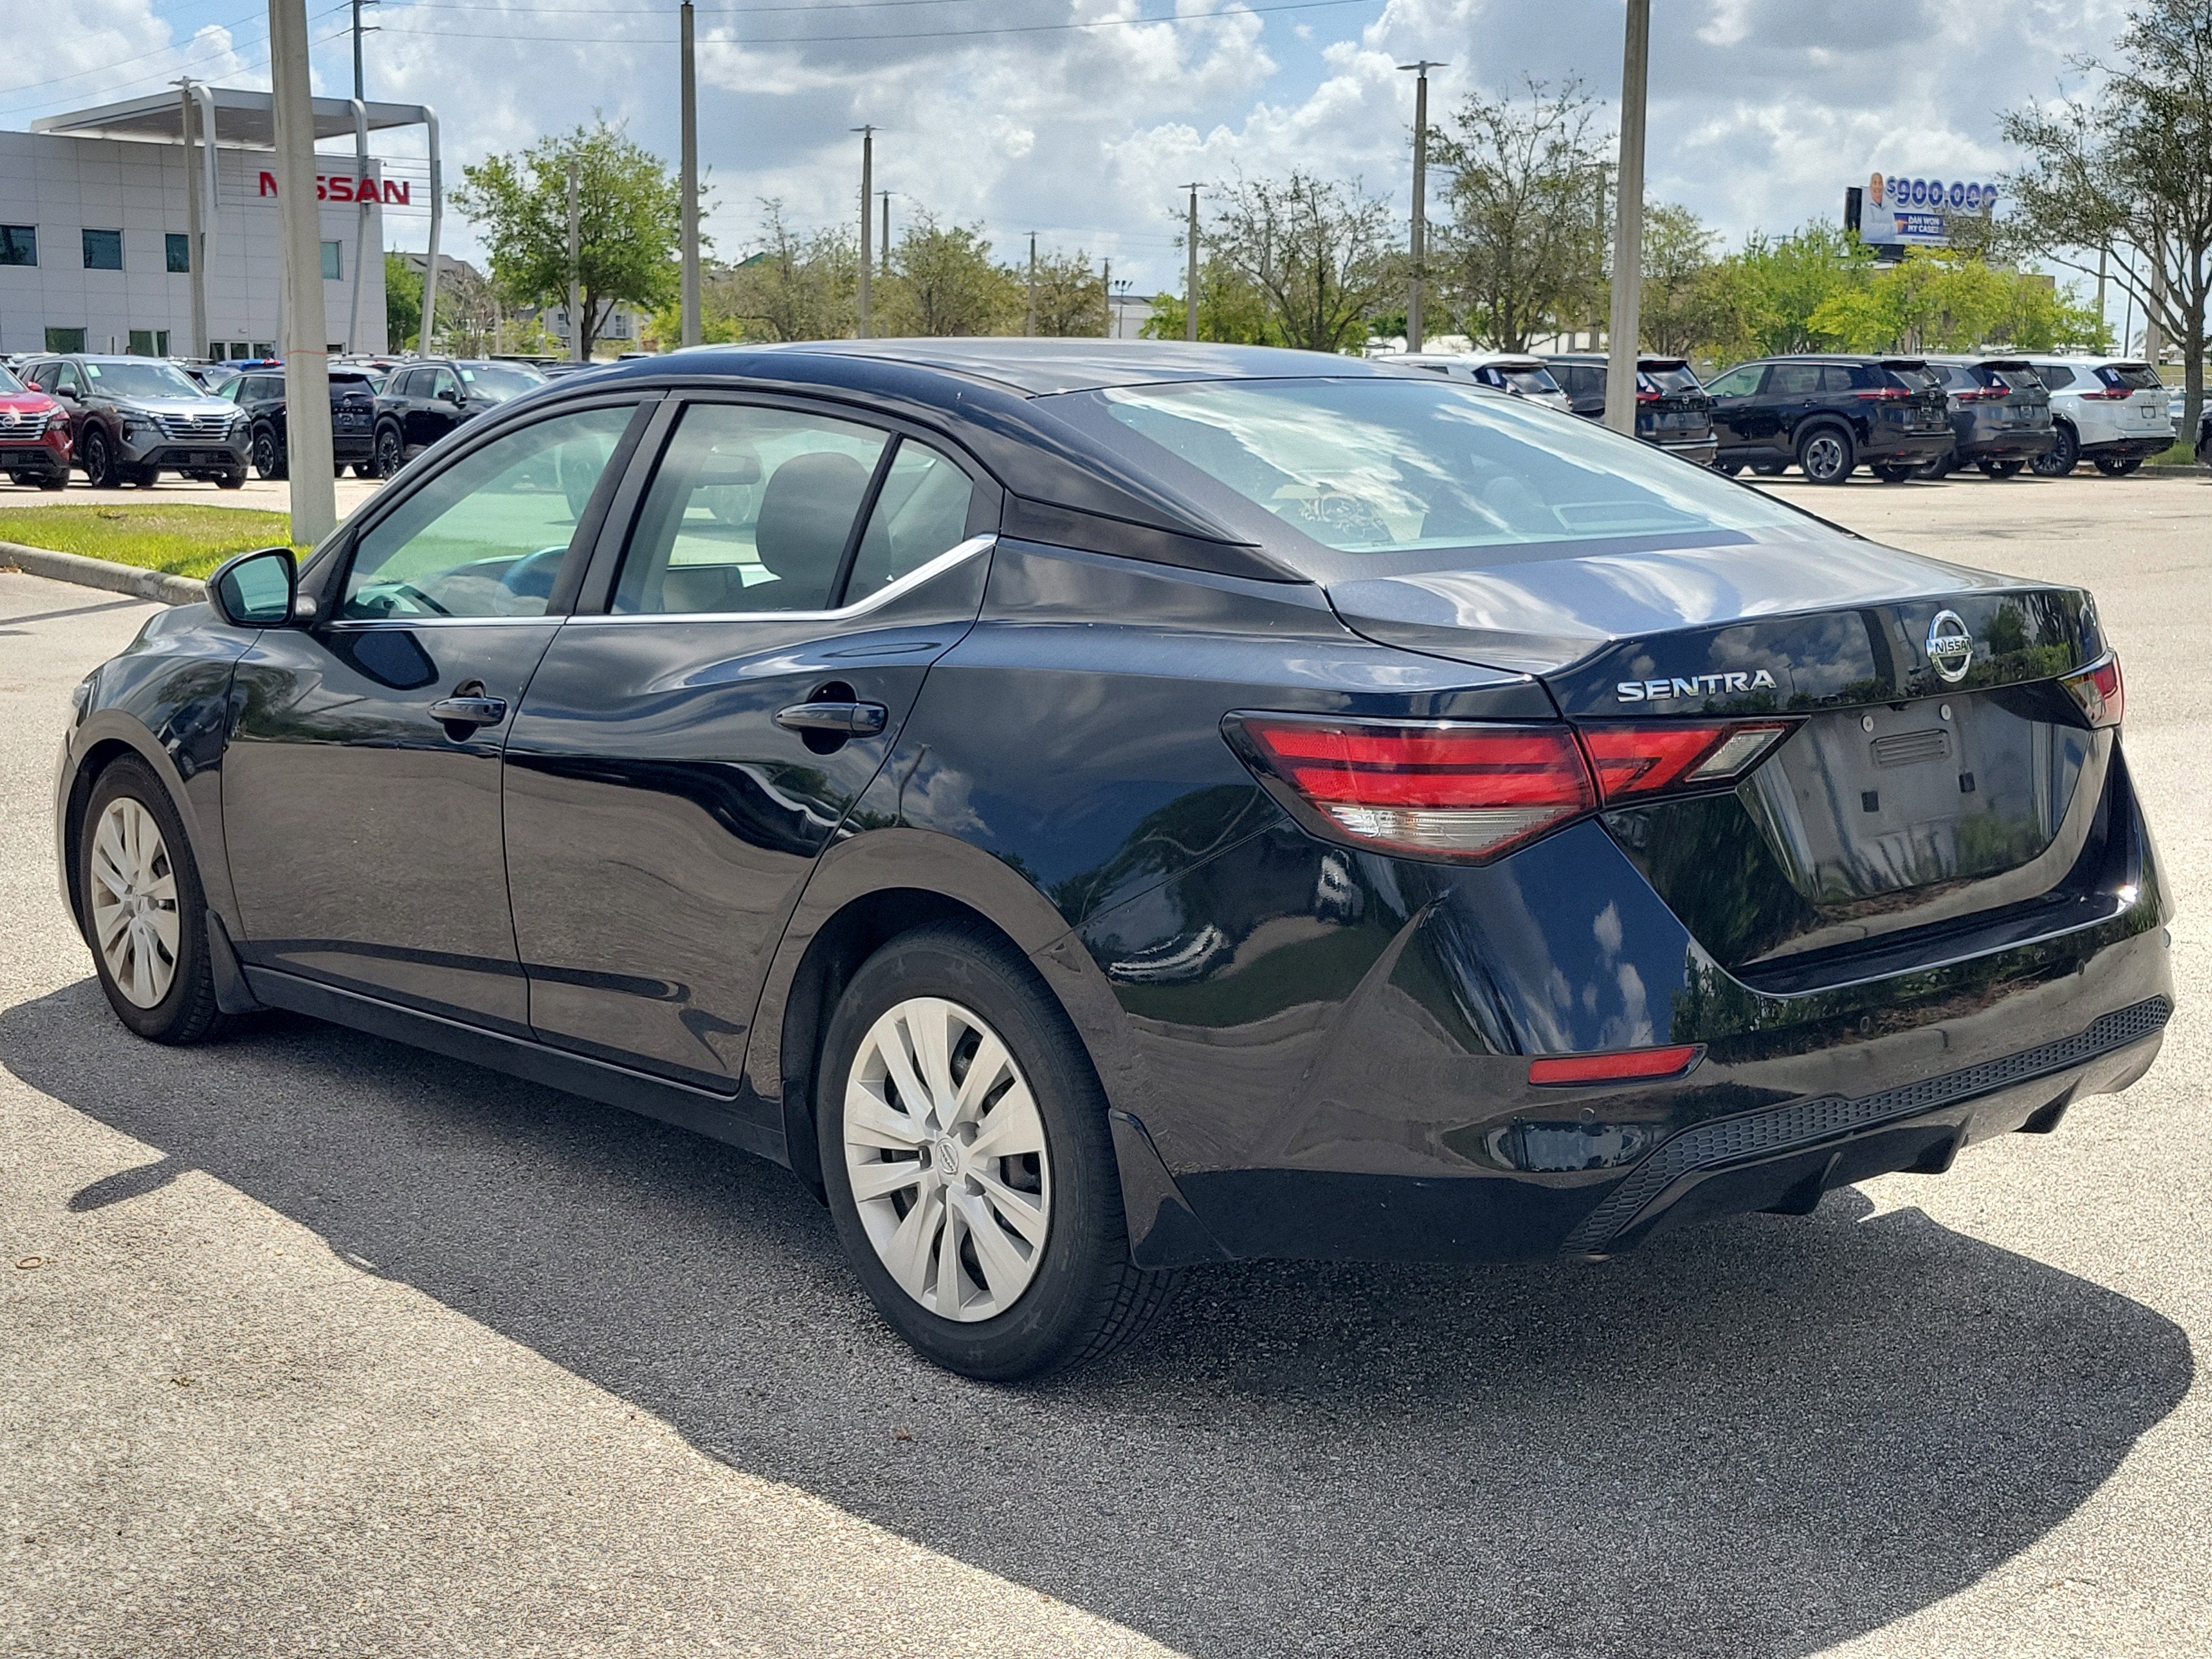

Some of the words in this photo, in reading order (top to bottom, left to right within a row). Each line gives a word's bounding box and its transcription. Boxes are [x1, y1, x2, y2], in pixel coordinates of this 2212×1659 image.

[1908, 215, 1922, 225] DAN
[1923, 216, 1939, 225] WON
[1934, 640, 1972, 653] NISSAN
[1617, 669, 1777, 702] SENTRA
